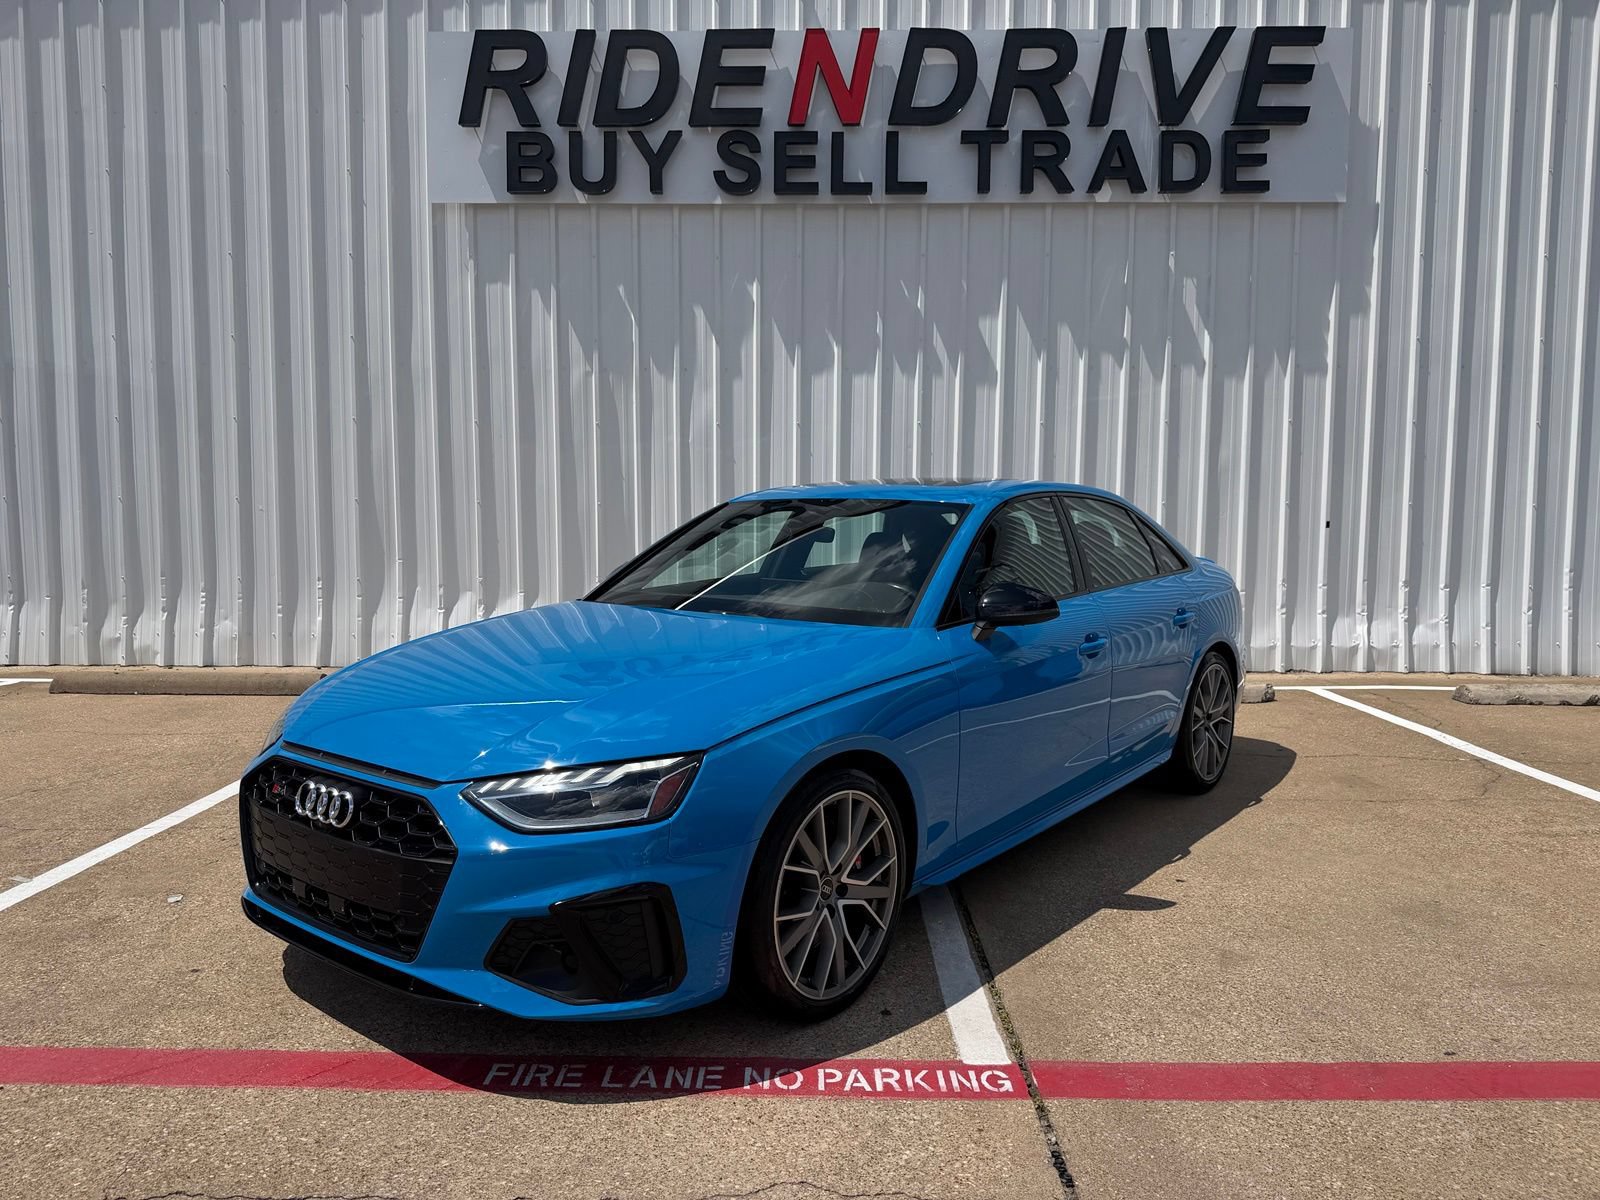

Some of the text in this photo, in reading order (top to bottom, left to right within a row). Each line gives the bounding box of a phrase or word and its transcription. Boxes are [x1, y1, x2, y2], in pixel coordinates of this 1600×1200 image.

[506, 129, 1271, 195] BUY SELL TRADE
[482, 1063, 1014, 1093] FIRE LANE NO PARKING
